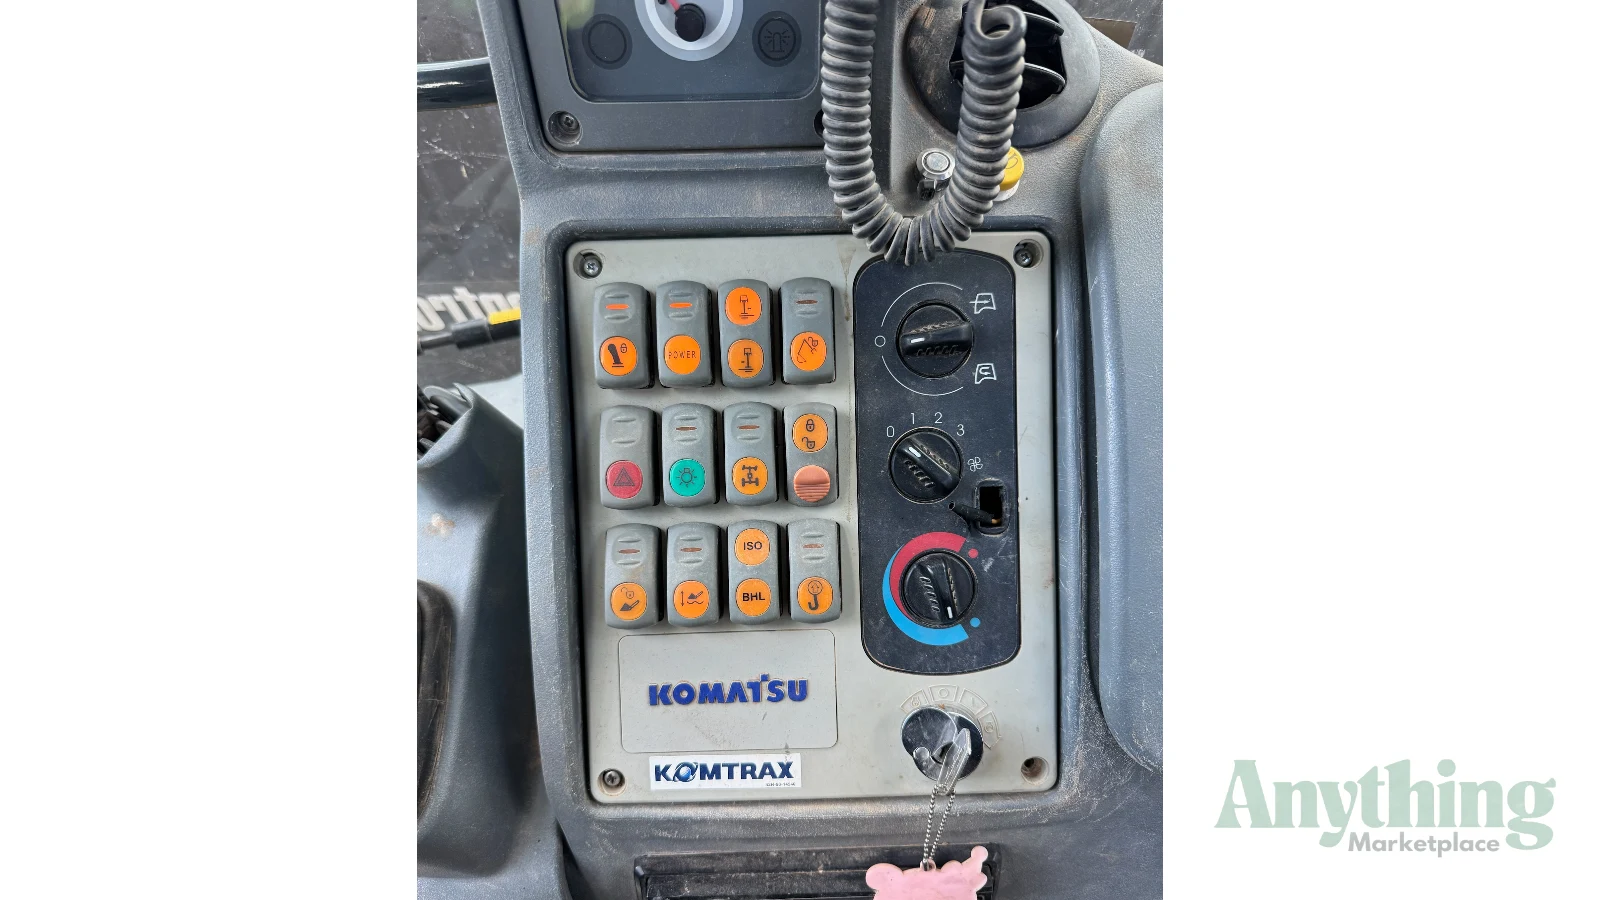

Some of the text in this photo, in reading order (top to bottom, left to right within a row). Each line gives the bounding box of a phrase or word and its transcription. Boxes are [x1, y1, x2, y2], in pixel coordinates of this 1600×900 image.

[668, 350, 697, 360] POWER
[886, 412, 965, 438] 0 1 2 3
[743, 541, 763, 551] ISO
[742, 592, 765, 602] BHL
[648, 673, 809, 706] KOMATSU
[654, 761, 794, 783] KOMTRAX
